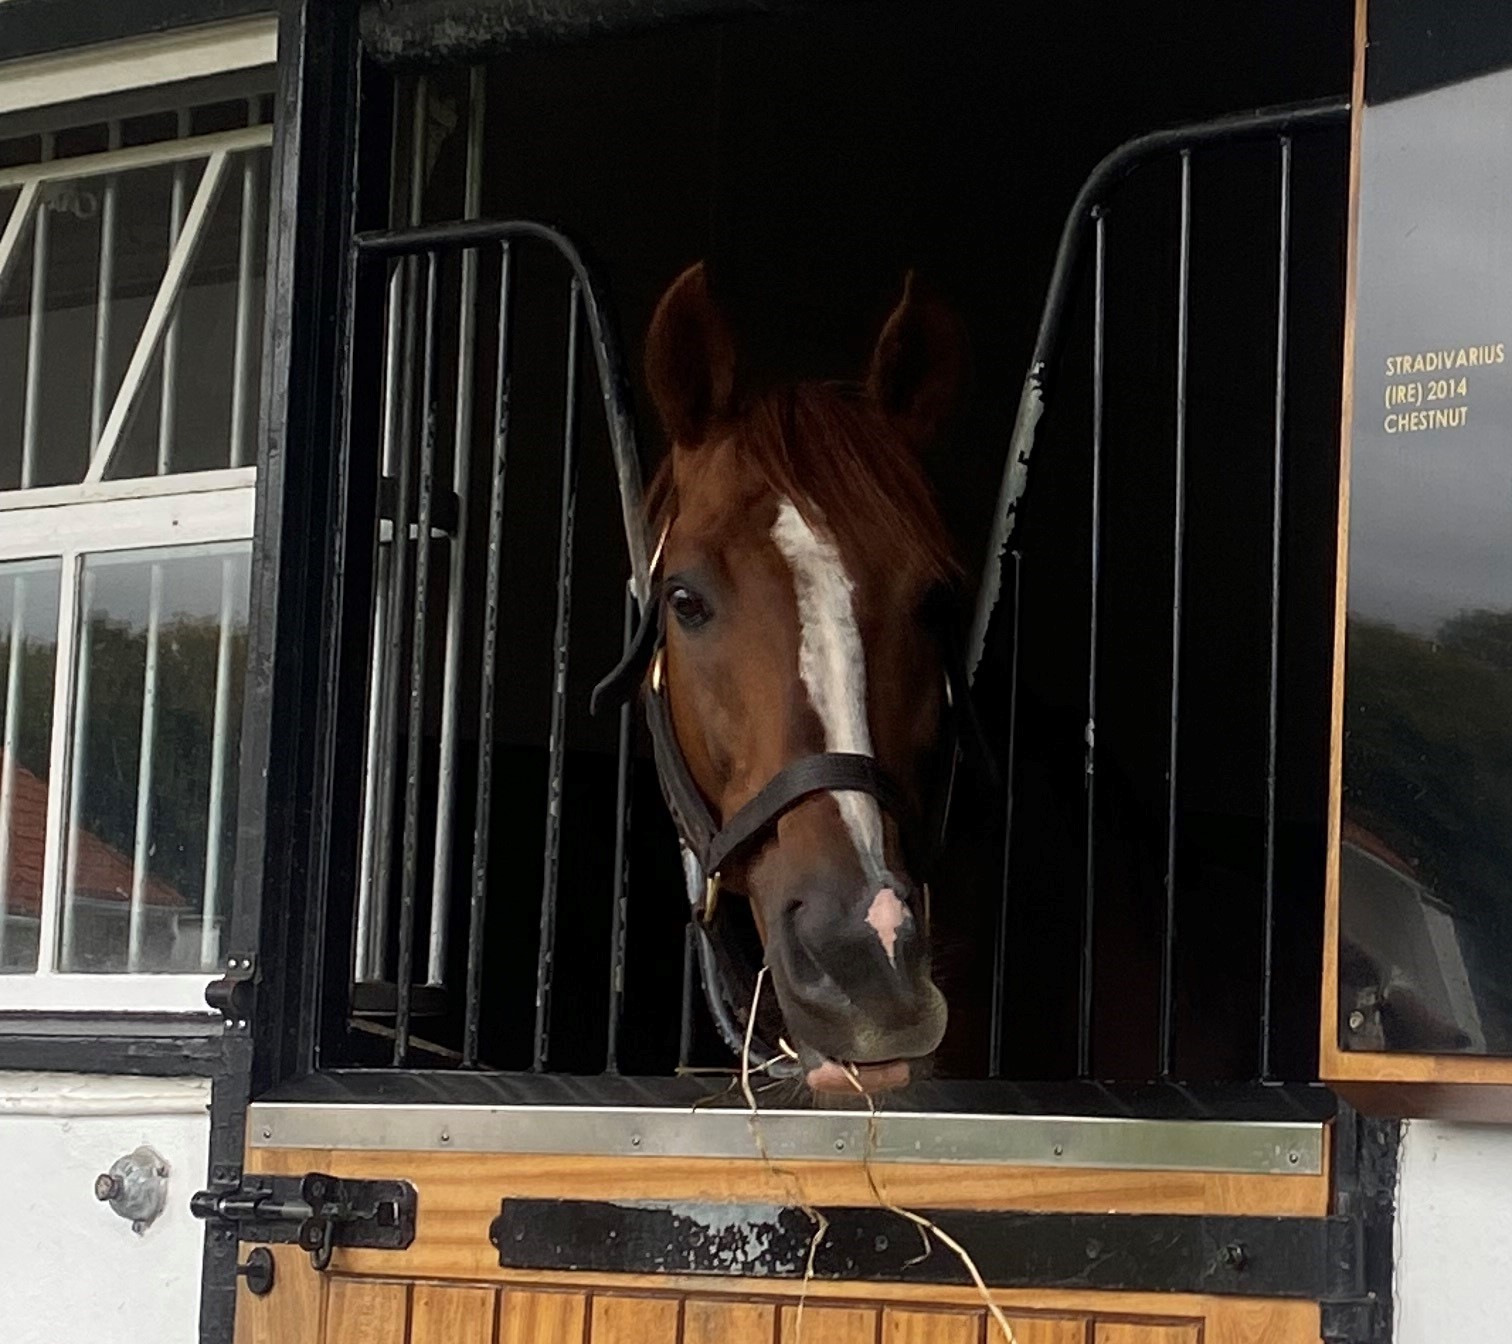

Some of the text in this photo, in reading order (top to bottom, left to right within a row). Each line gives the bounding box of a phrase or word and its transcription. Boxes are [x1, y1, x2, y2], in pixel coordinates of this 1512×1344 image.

[1385, 343, 1505, 376] STRADIVARIUS
[1385, 378, 1468, 407] (IRE) 2014
[1384, 406, 1468, 433] CHESTNUT
